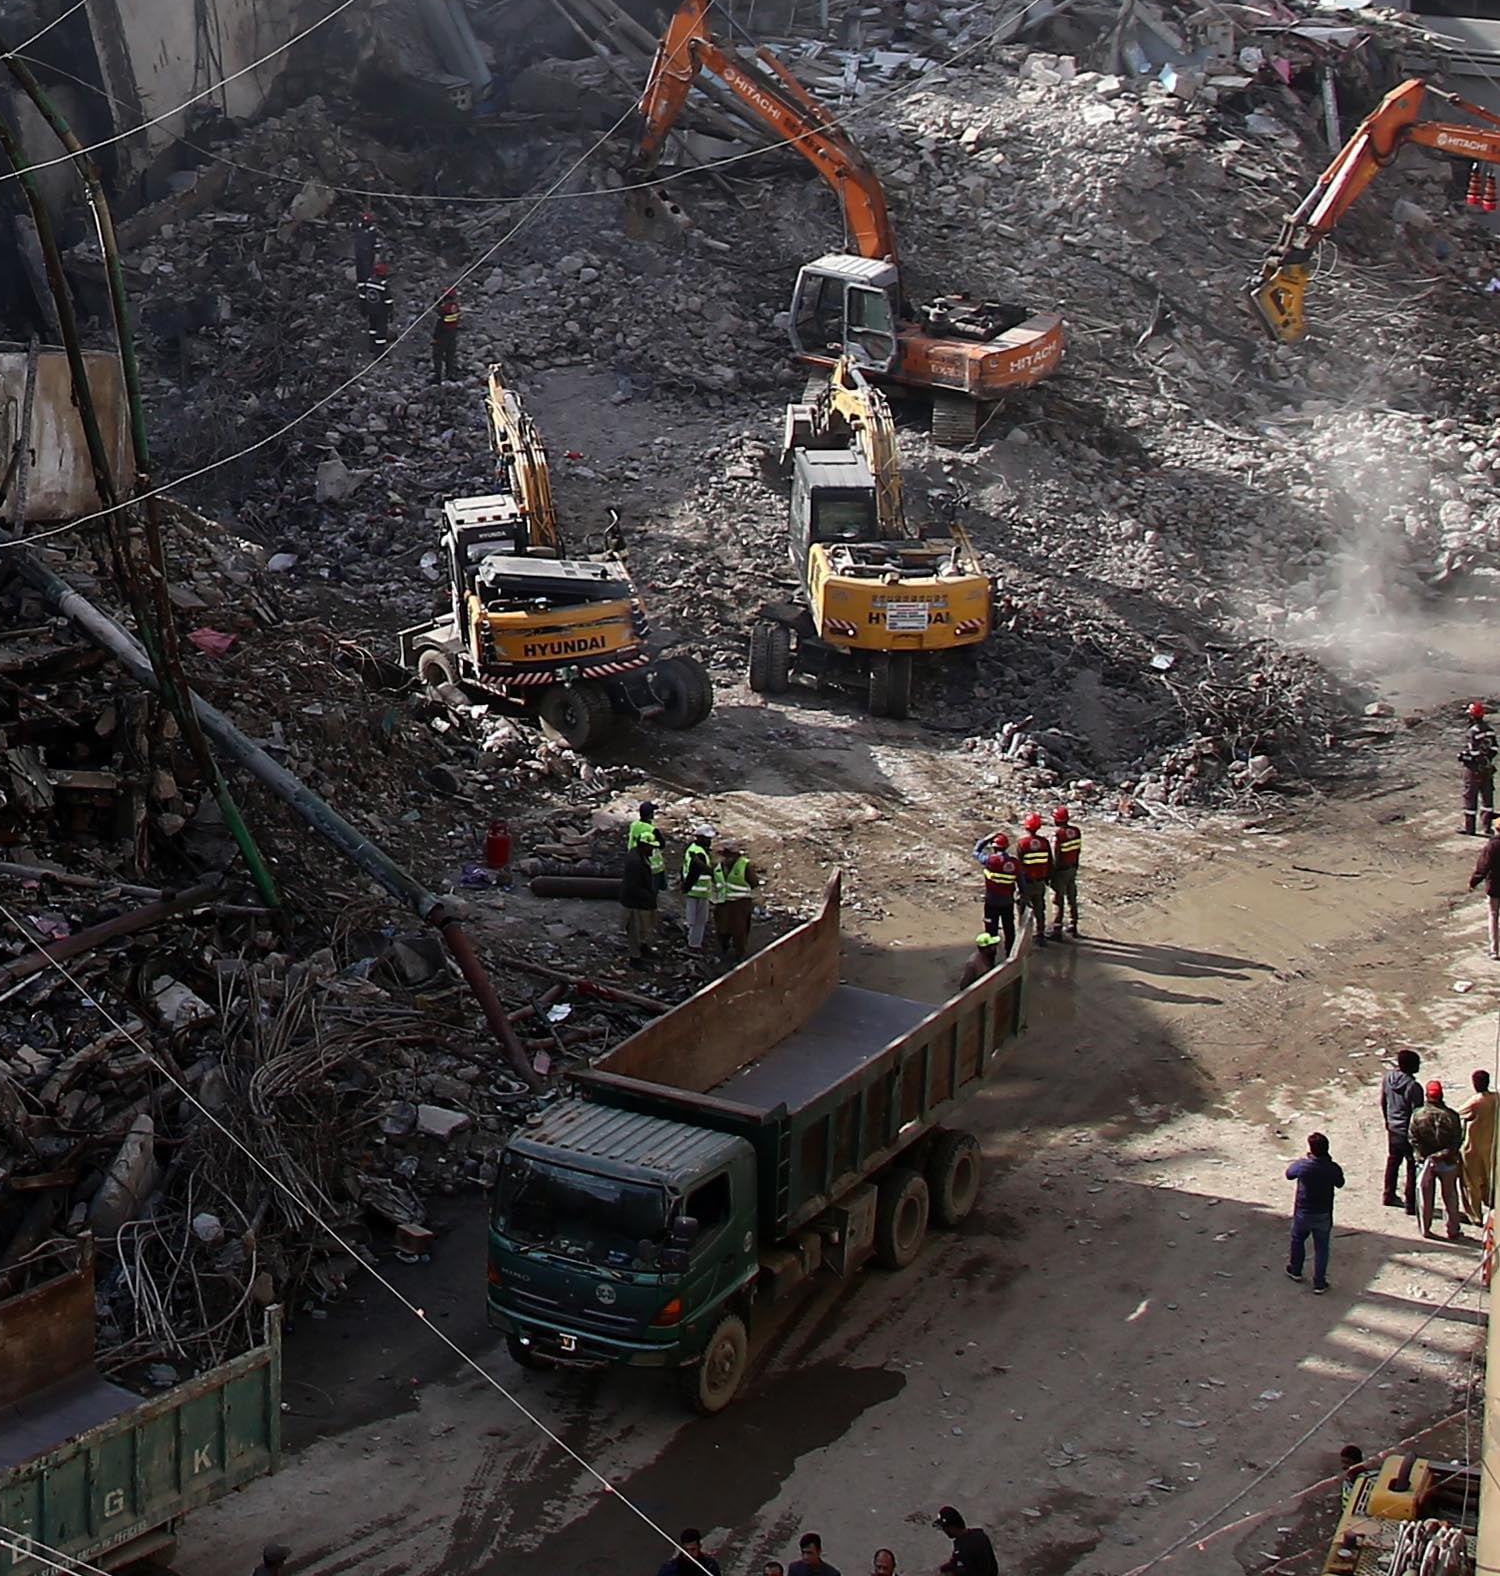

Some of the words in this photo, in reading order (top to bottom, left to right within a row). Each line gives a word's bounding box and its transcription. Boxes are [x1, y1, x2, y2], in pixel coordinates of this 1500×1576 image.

[733, 76, 782, 121] HITACHI
[1448, 136, 1488, 152] HITACHI
[524, 635, 606, 657] HYUNDAI
[104, 1488, 124, 1518] G
[193, 1442, 213, 1474] K
